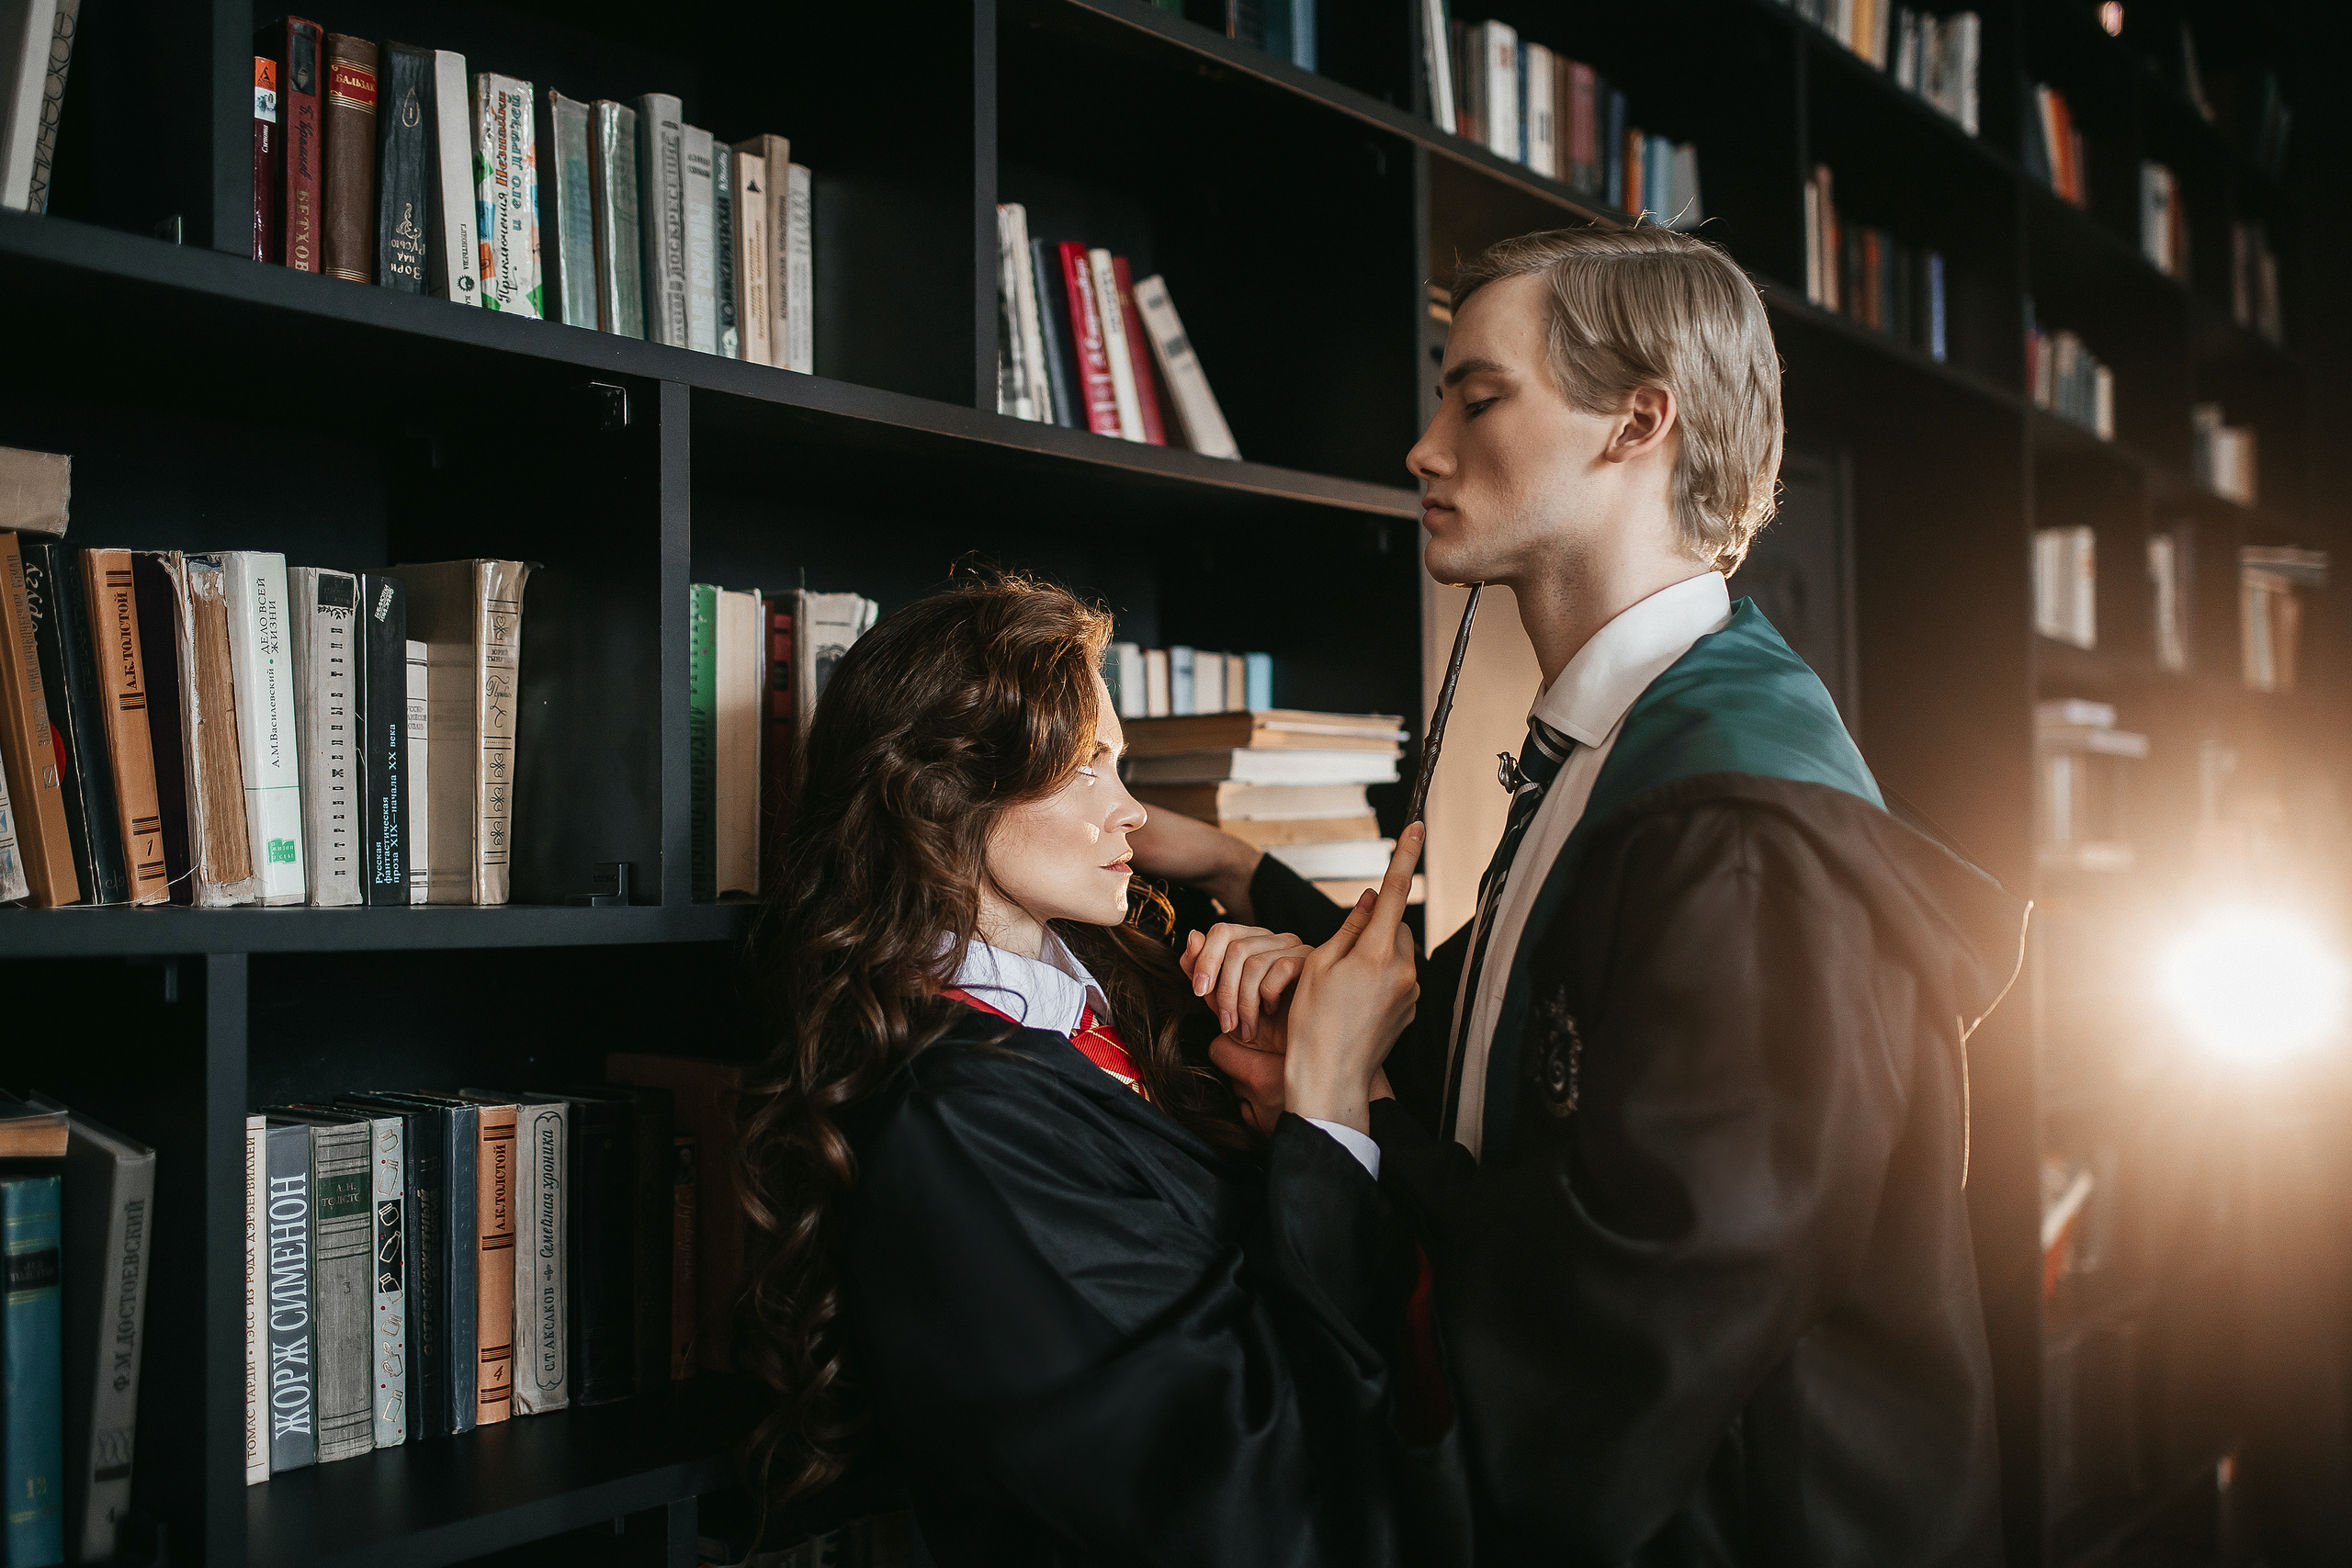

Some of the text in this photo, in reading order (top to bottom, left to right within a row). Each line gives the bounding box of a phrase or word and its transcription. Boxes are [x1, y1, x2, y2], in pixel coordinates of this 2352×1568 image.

[335, 73, 376, 93] БАЛЬЗАК
[506, 94, 524, 231] и его друзей
[494, 90, 517, 303] Приключения Незнайки
[390, 236, 426, 255] Русью
[397, 252, 415, 263] над
[390, 263, 423, 280] Зори
[254, 576, 267, 612] ВСЕЙ
[257, 615, 271, 655] ДЕЛО
[266, 599, 280, 654] ЖИЗНИ
[330, 626, 346, 877] ПОТРЕВОЖЕННЫЕ ТЕНИ
[388, 723, 397, 748] века
[382, 796, 392, 885] фантастическая
[375, 841, 384, 885] Русская
[390, 852, 401, 884] проза
[540, 1127, 560, 1190] хроника
[538, 1192, 554, 1259] Семейная
[268, 1171, 312, 1440] ЖОРЖ СИМЕНОН
[246, 1360, 257, 1404] ГАРДИ
[246, 1409, 257, 1460] ТОМАС
